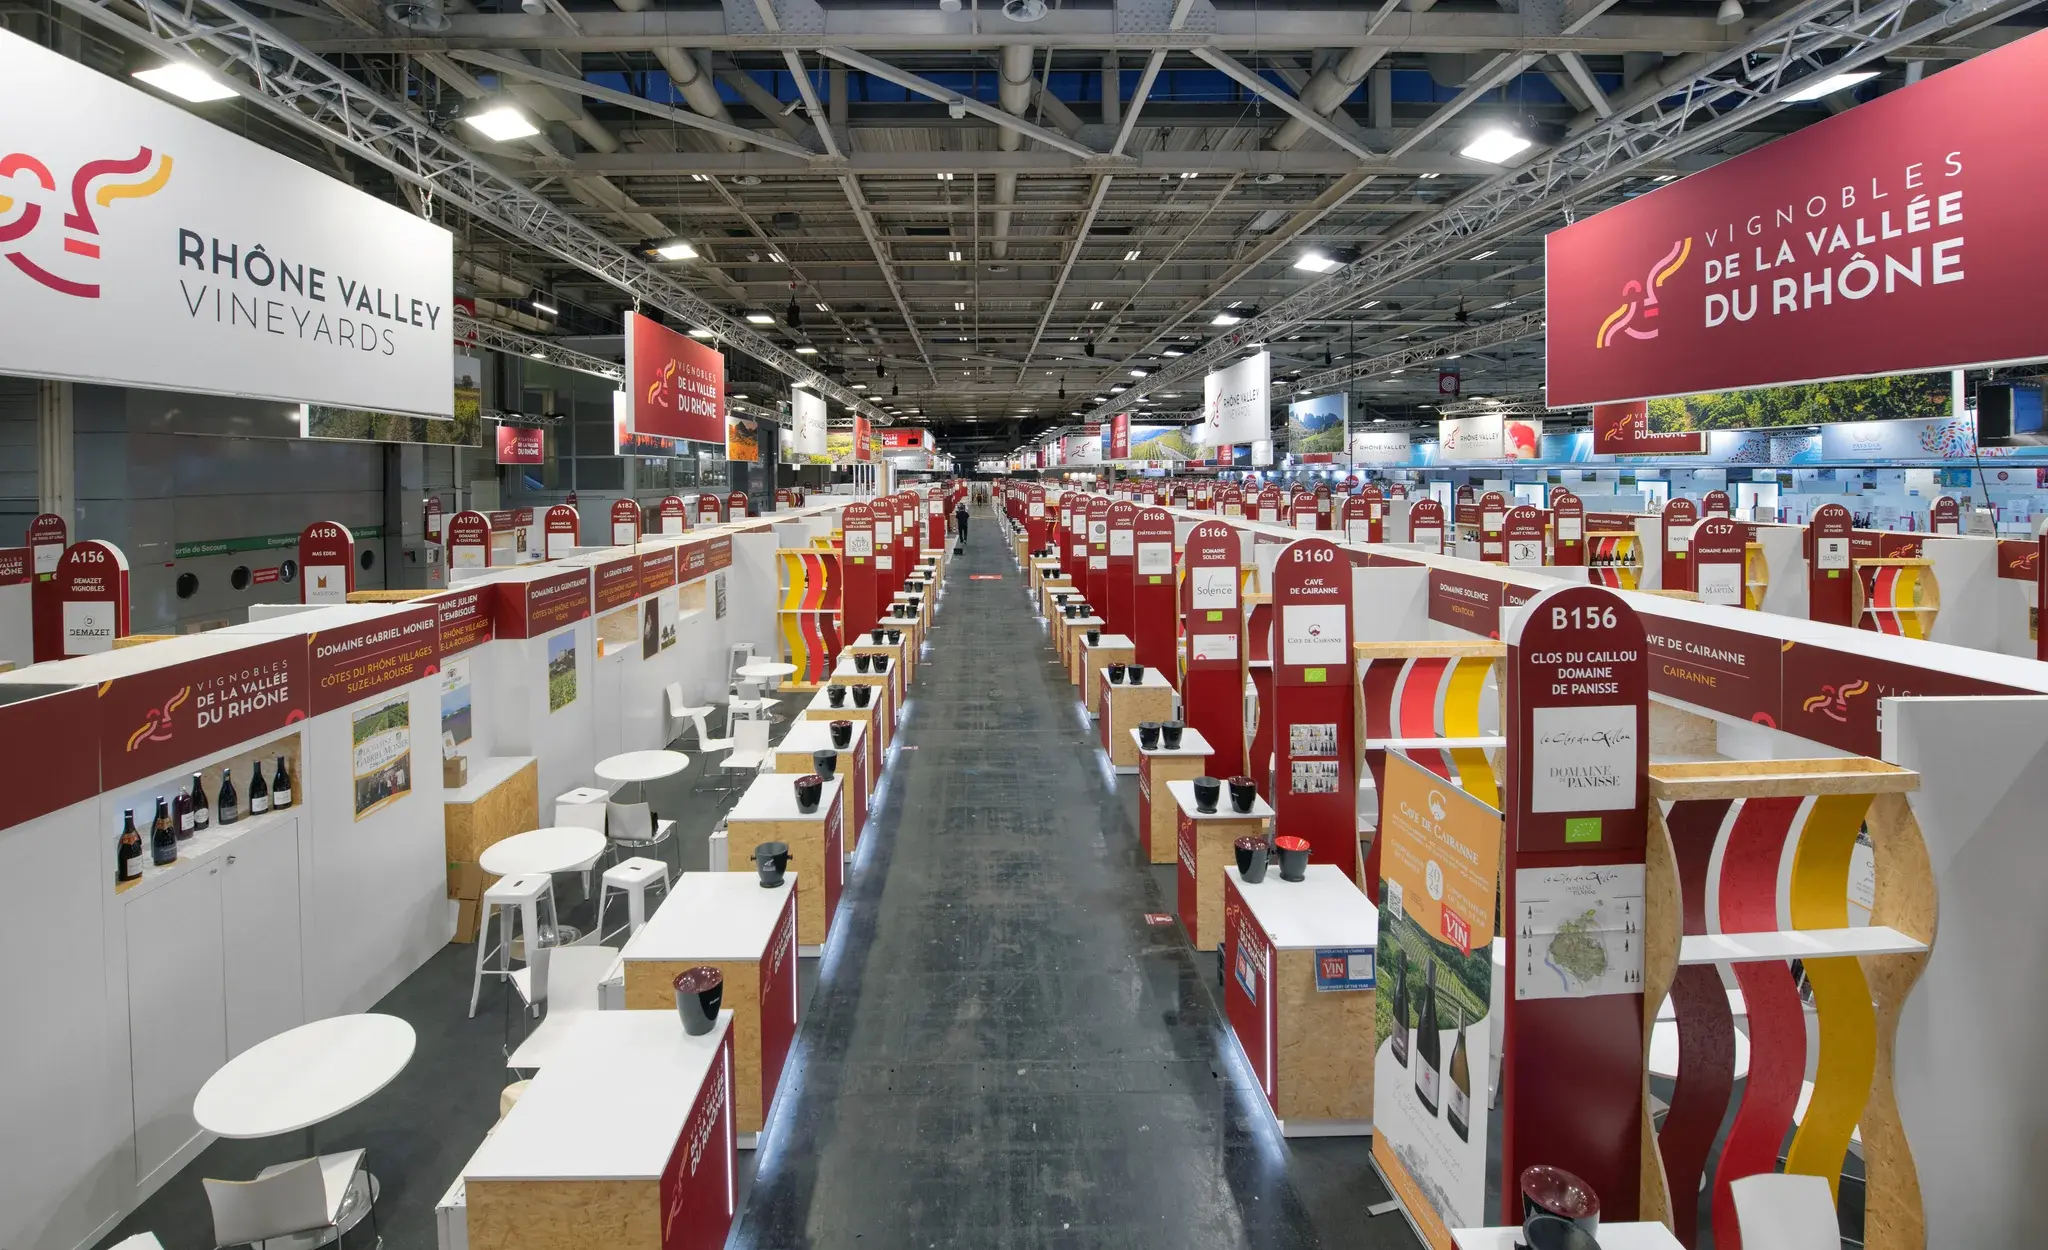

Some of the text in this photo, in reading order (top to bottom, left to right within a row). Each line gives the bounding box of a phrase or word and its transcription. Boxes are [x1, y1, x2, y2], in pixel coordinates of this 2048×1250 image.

[1705, 151, 1963, 248] VIGNOBLES
[1705, 190, 1964, 285] DE LA VALLÉE
[178, 228, 441, 331] RHÔNE VALLEY
[1705, 237, 1965, 328] DU RHÔNE
[179, 279, 396, 356] VINEYARDS
[678, 361, 716, 383] VIGNOBLES
[678, 376, 716, 398] DE LA VALLÉE
[678, 393, 716, 418] DU RHÔNE
[1224, 395, 1239, 408] RHÔNE
[1460, 433, 1499, 442] RHÔNE VALLEY
[1635, 431, 1647, 439] DU
[1418, 503, 1437, 511] C177
[1823, 509, 1843, 517] C170
[38, 518, 58, 526] A157
[457, 516, 479, 524] A170
[1514, 511, 1536, 519] C169
[310, 528, 337, 538] A158
[1199, 528, 1228, 538] B166
[1706, 525, 1734, 534] C157
[70, 551, 105, 563] A156
[175, 547, 190, 555] ortie
[201, 544, 227, 553] Secours
[1293, 549, 1334, 563] B160
[1197, 575, 1232, 595] Solence
[1304, 578, 1324, 586] CAVE
[531, 586, 554, 599] DOMAINE
[1302, 586, 1339, 595] CAIRANNE
[1439, 583, 1489, 602] DOMAINE SOLENCE
[1705, 586, 1734, 594] MARTIN
[458, 595, 478, 607] JULIEN
[440, 605, 476, 622] L'EMBISQUE
[1452, 604, 1475, 617] VENTOUX
[1552, 606, 1617, 630] B156
[443, 619, 489, 641] RHÔNE VILLAGES
[316, 619, 434, 659] DOMAINE GABRIEL MONIER
[1531, 651, 1638, 664] CLOS DU CAILLOU
[1646, 634, 1746, 666] AVE DE CAIRANNE
[320, 646, 433, 688] CÔTES DU RHÔNE VILLAGES
[1558, 667, 1613, 679] DOMAINE
[197, 659, 288, 692] VIGNOBLES
[347, 664, 414, 694] SUZE-LA-ROUSSE
[1663, 664, 1717, 687] CAIRANNE
[197, 671, 288, 708] DE LA VALLÉE
[1552, 682, 1619, 695] DE PANISSE
[197, 686, 288, 729] DU RHÔNE
[1550, 765, 1612, 779] DOMAINE
[1567, 776, 1621, 788] PANISSE
[1400, 801, 1419, 824] CAVE
[1421, 817, 1432, 832] DE
[1434, 824, 1480, 866] CAIRANNE
[1443, 913, 1468, 948] VIN
[1323, 962, 1344, 974] VIN
[690, 1061, 723, 1140] VIGNOBLES
[691, 1086, 724, 1177] DU RHÔNE
[691, 1136, 698, 1157] DE
[699, 1118, 706, 1136] LA
